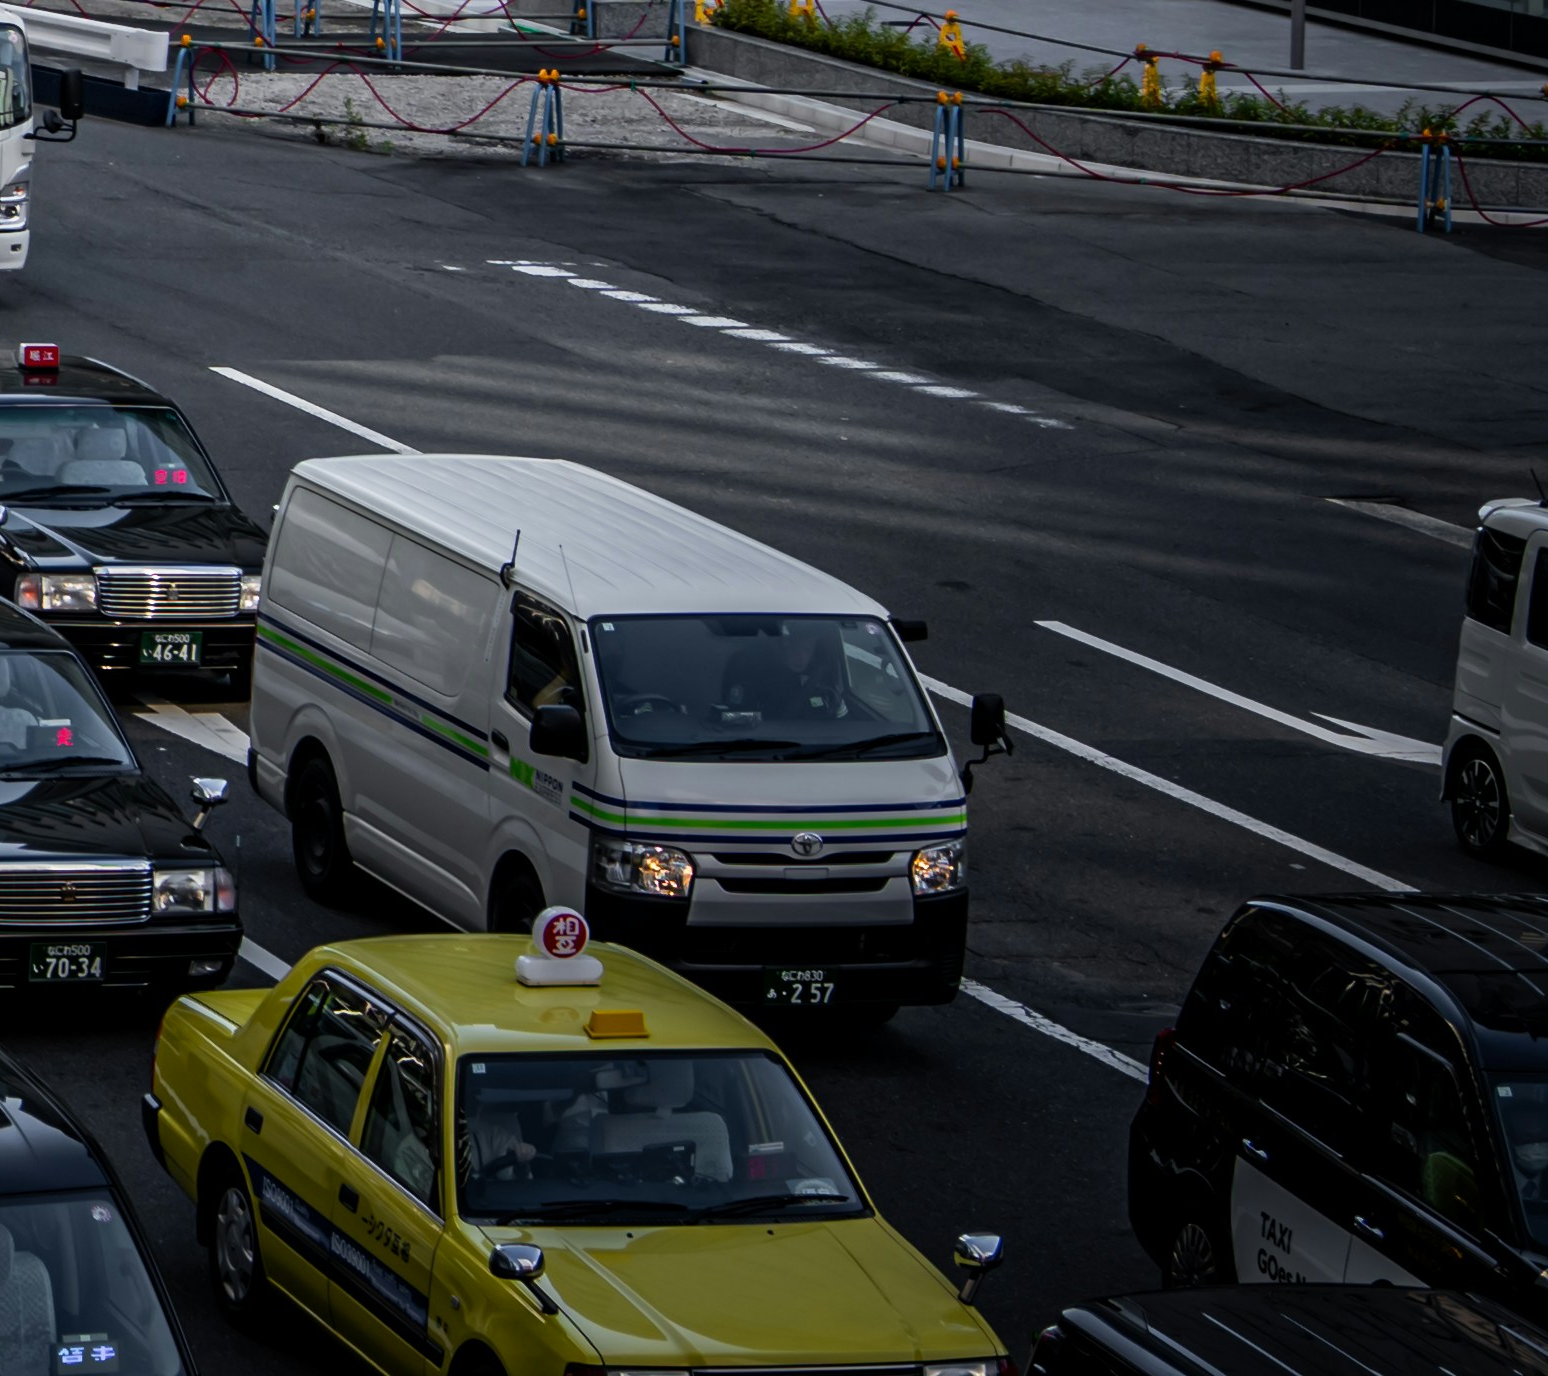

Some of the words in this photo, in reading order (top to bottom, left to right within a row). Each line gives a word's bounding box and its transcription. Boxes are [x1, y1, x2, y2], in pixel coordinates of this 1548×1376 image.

[154, 633, 190, 643] なにわ500
[152, 644, 197, 661] 46-41
[536, 769, 564, 793] NIPPON
[552, 916, 580, 956] 相互
[47, 944, 91, 956] なにわ500
[45, 956, 102, 978] 70-34
[781, 970, 824, 981] なにわ830
[1260, 1211, 1293, 1254] TAXI
